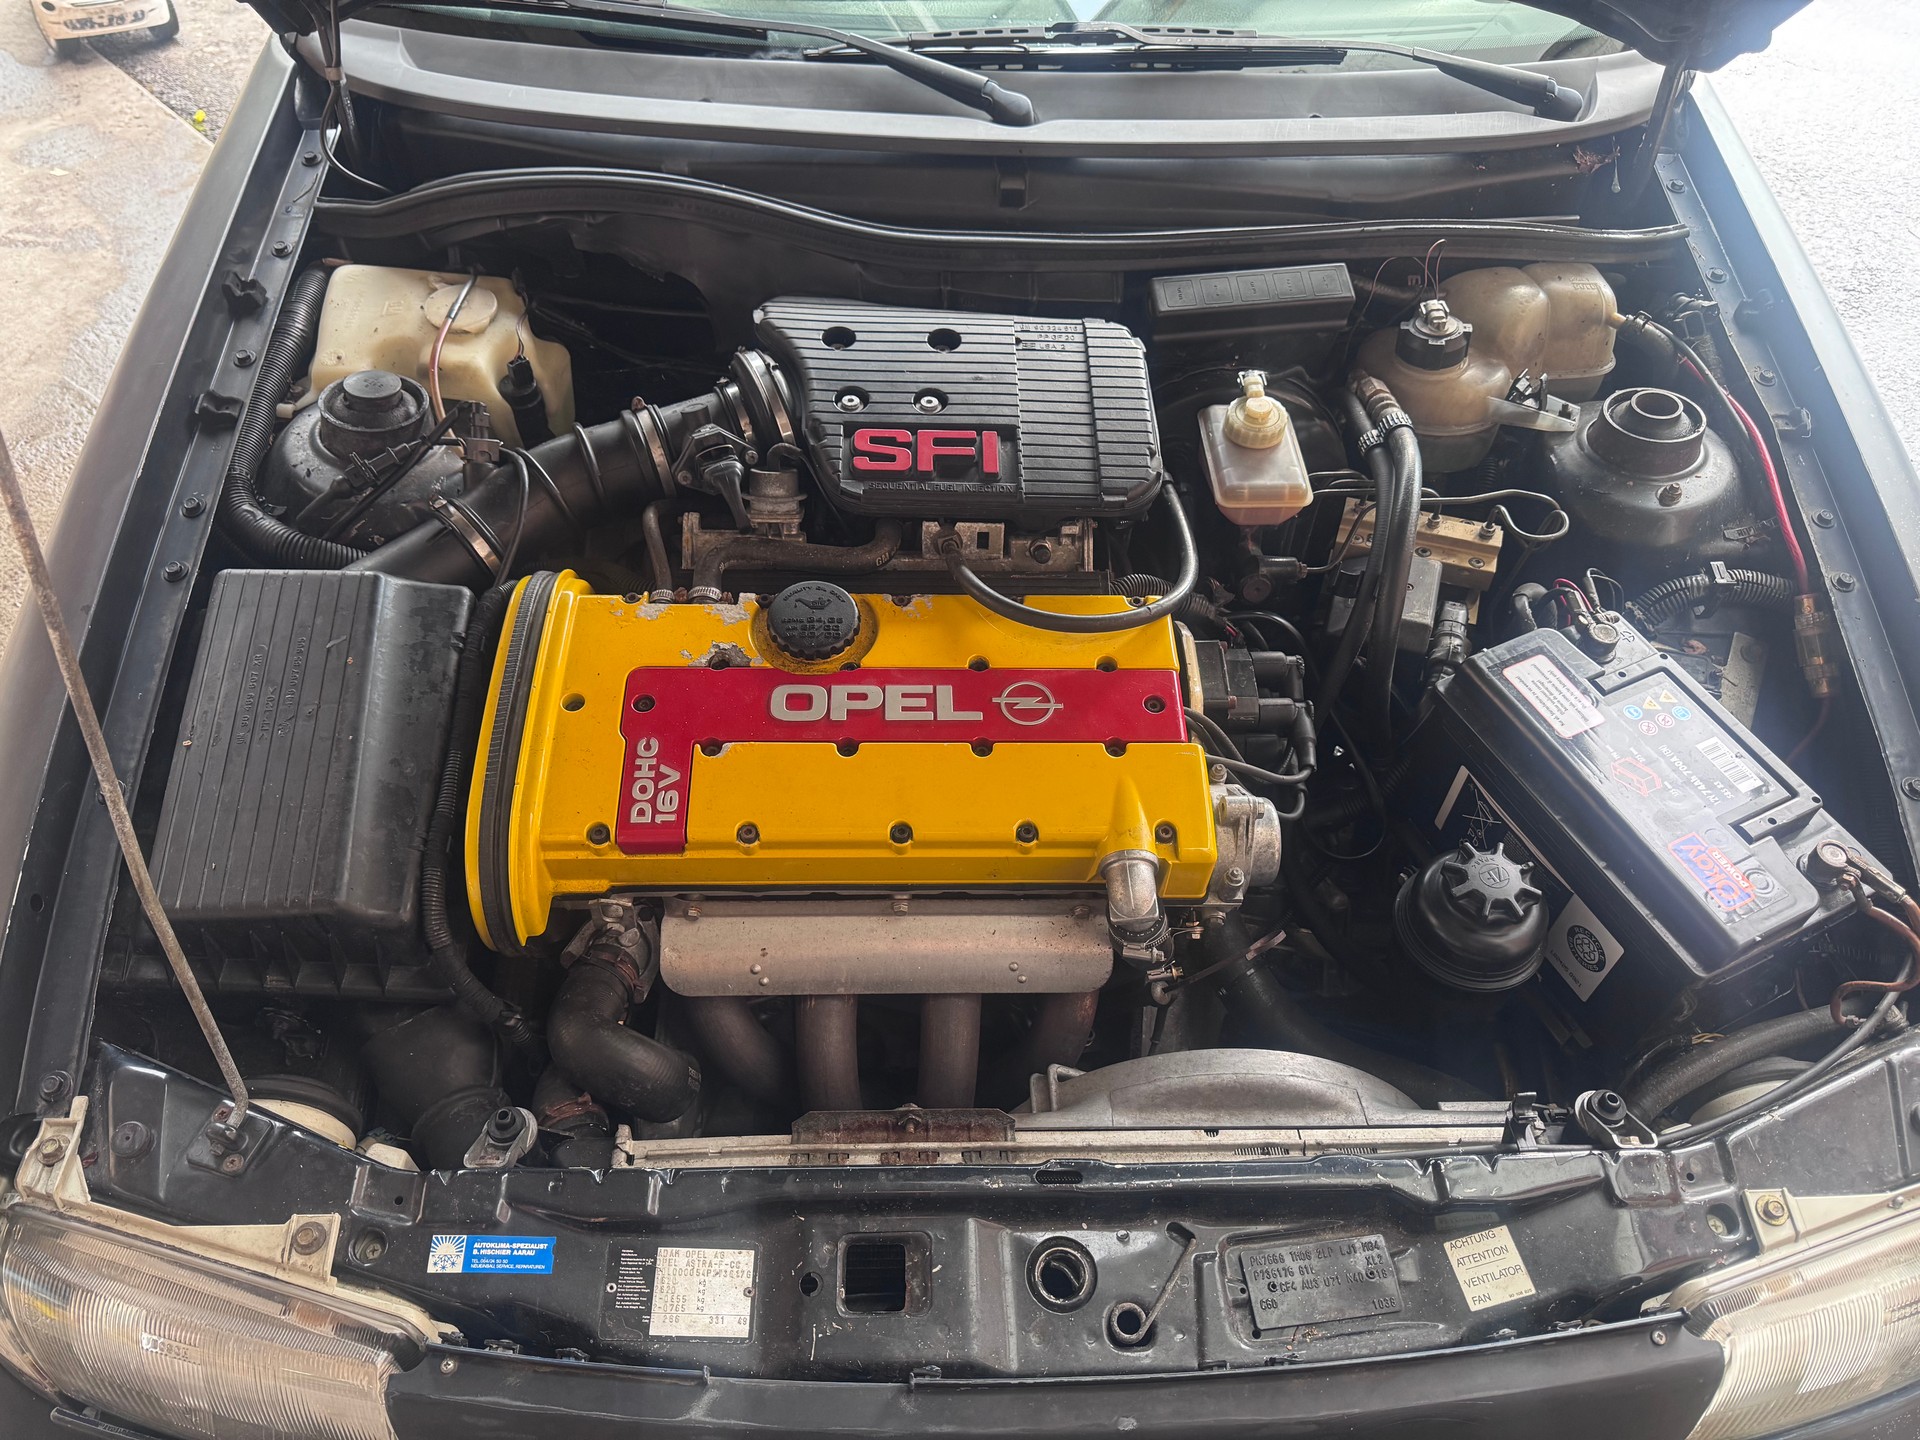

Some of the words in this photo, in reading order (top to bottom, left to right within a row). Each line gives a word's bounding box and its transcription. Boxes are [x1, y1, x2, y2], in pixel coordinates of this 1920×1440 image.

[853, 428, 999, 474] SFI
[868, 481, 930, 491] SEQUENTIAL
[934, 482, 960, 492] FUEL
[770, 684, 983, 722] OPEL
[630, 736, 659, 824] DOHC
[655, 764, 681, 824] 16V
[1712, 850, 1749, 888] POWER
[1449, 1230, 1496, 1251] ACHTUNG
[657, 1258, 678, 1266] OPEL
[658, 1249, 680, 1257] ADAM
[686, 1250, 707, 1258] OPEL
[1456, 1244, 1509, 1268] ATTENTION
[1464, 1264, 1524, 1288] VENTILATOR
[1472, 1292, 1492, 1306] FAN
